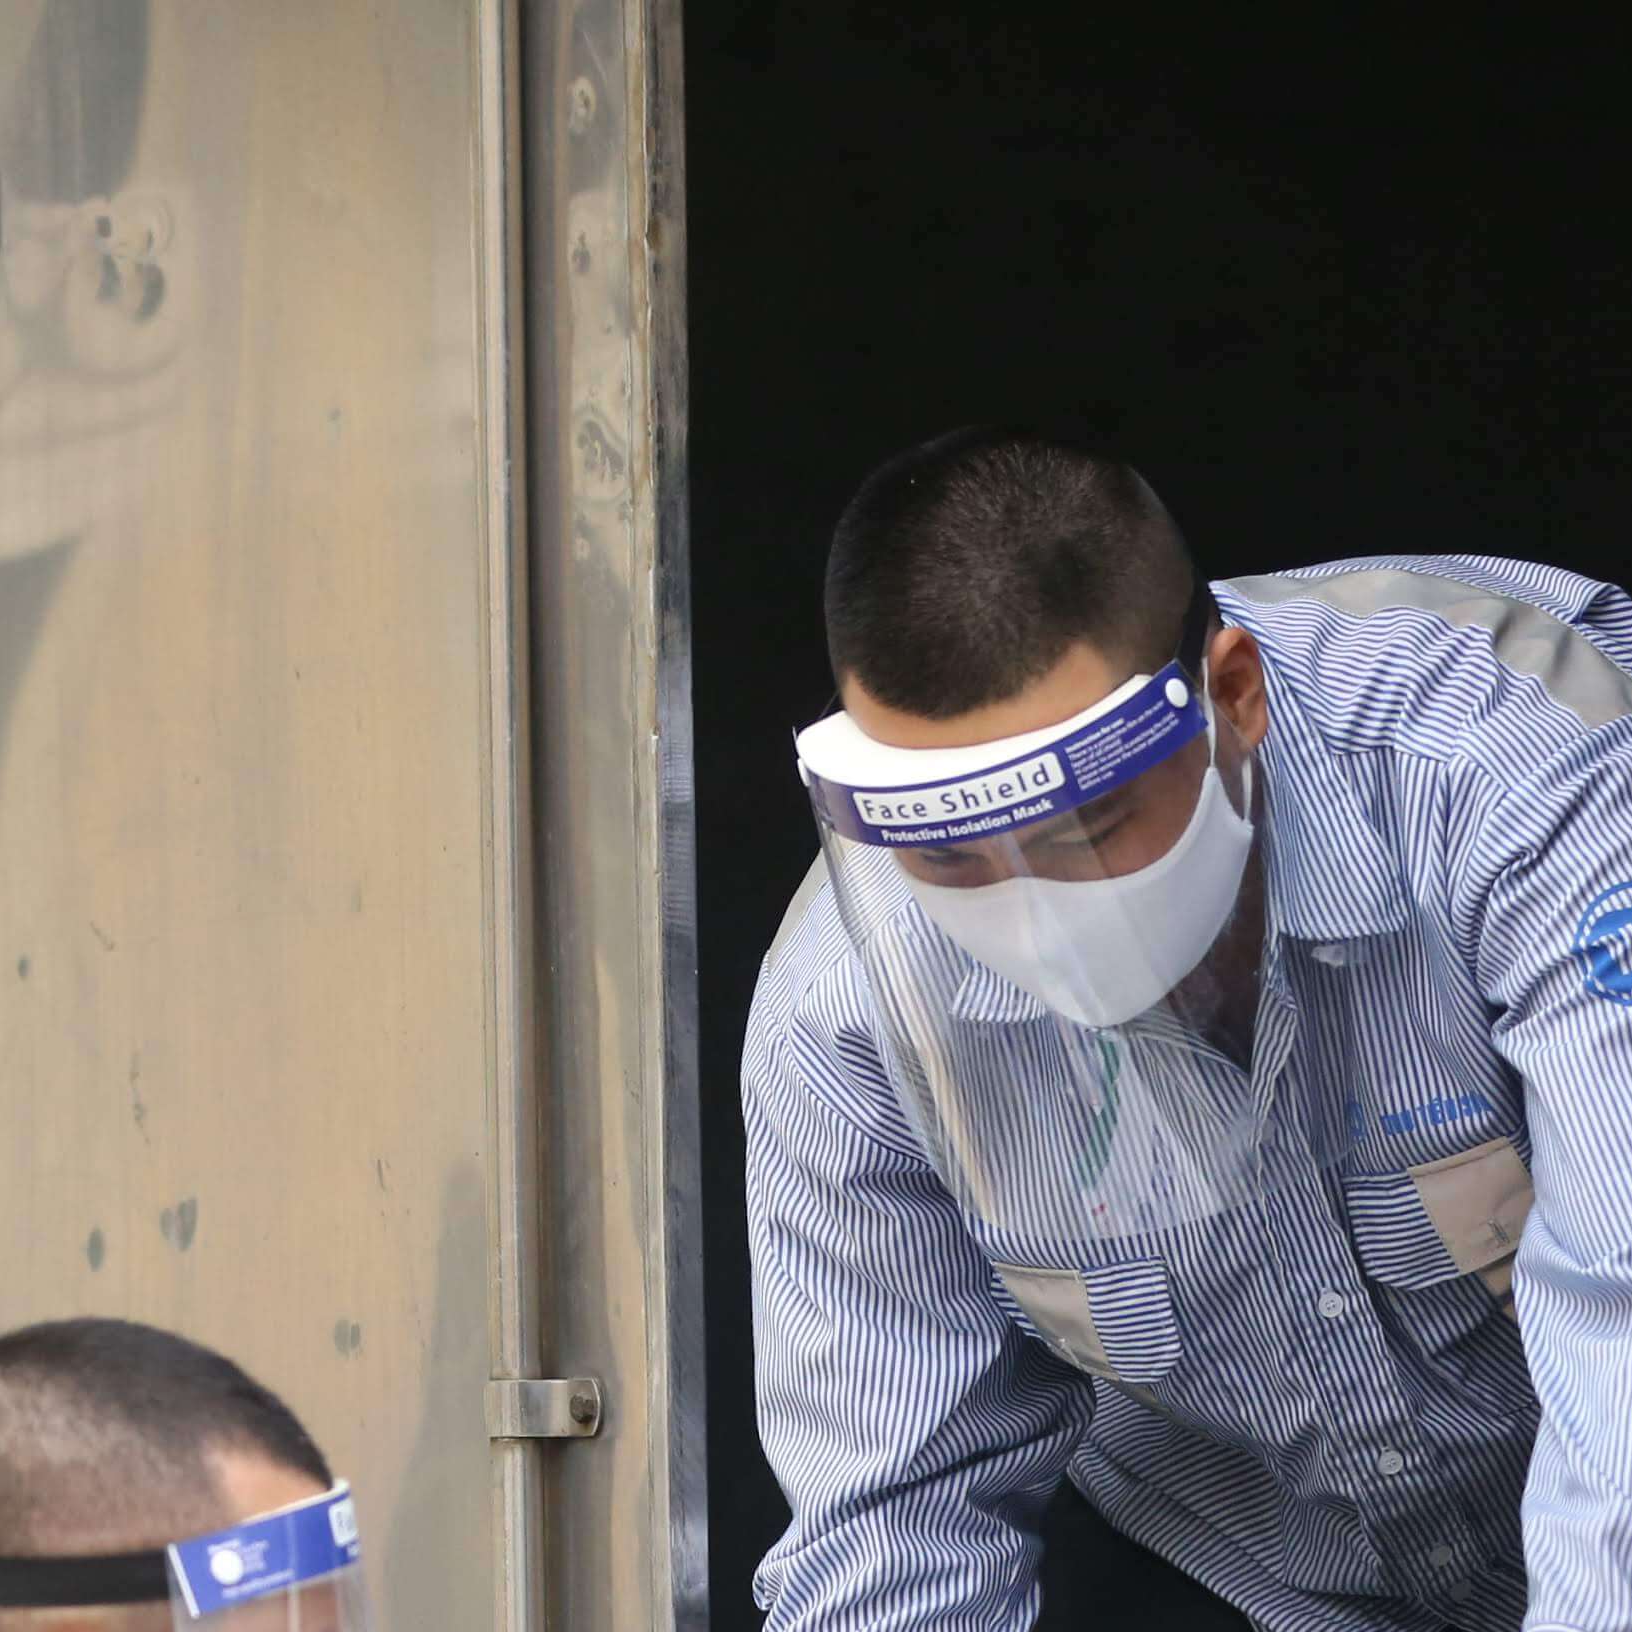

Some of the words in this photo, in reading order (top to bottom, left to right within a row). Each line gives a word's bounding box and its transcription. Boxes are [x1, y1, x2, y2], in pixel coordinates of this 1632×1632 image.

[861, 798, 928, 820] Face
[939, 762, 1050, 814] Shield
[881, 828, 948, 842] Protective
[947, 814, 1012, 837] Isolation
[1011, 797, 1054, 822] Mask
